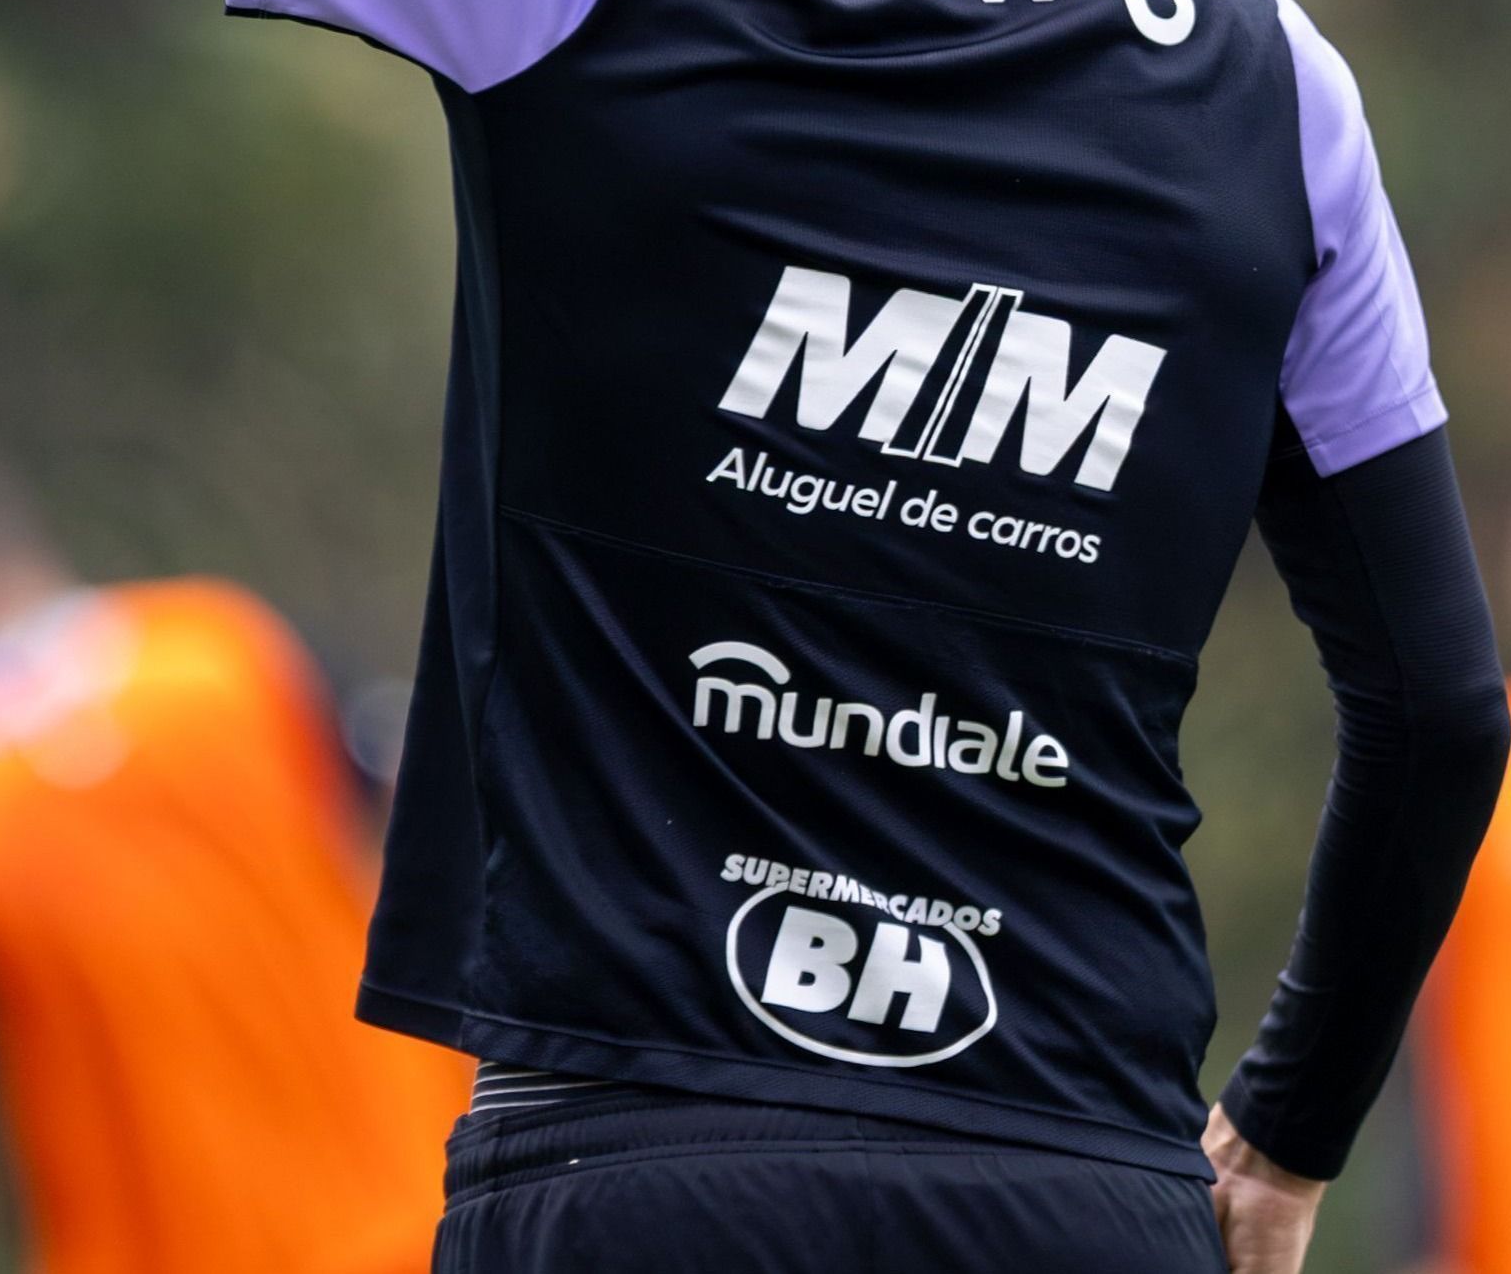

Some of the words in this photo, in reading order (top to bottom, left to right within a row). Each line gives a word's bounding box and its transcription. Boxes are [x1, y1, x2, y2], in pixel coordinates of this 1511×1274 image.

[706, 447, 898, 515] Aluguel
[899, 488, 960, 534] de
[966, 510, 1102, 564] carros
[692, 676, 1070, 788] mundiale
[720, 853, 1002, 937] SUPERMERCADOS
[760, 904, 951, 1033] BH
